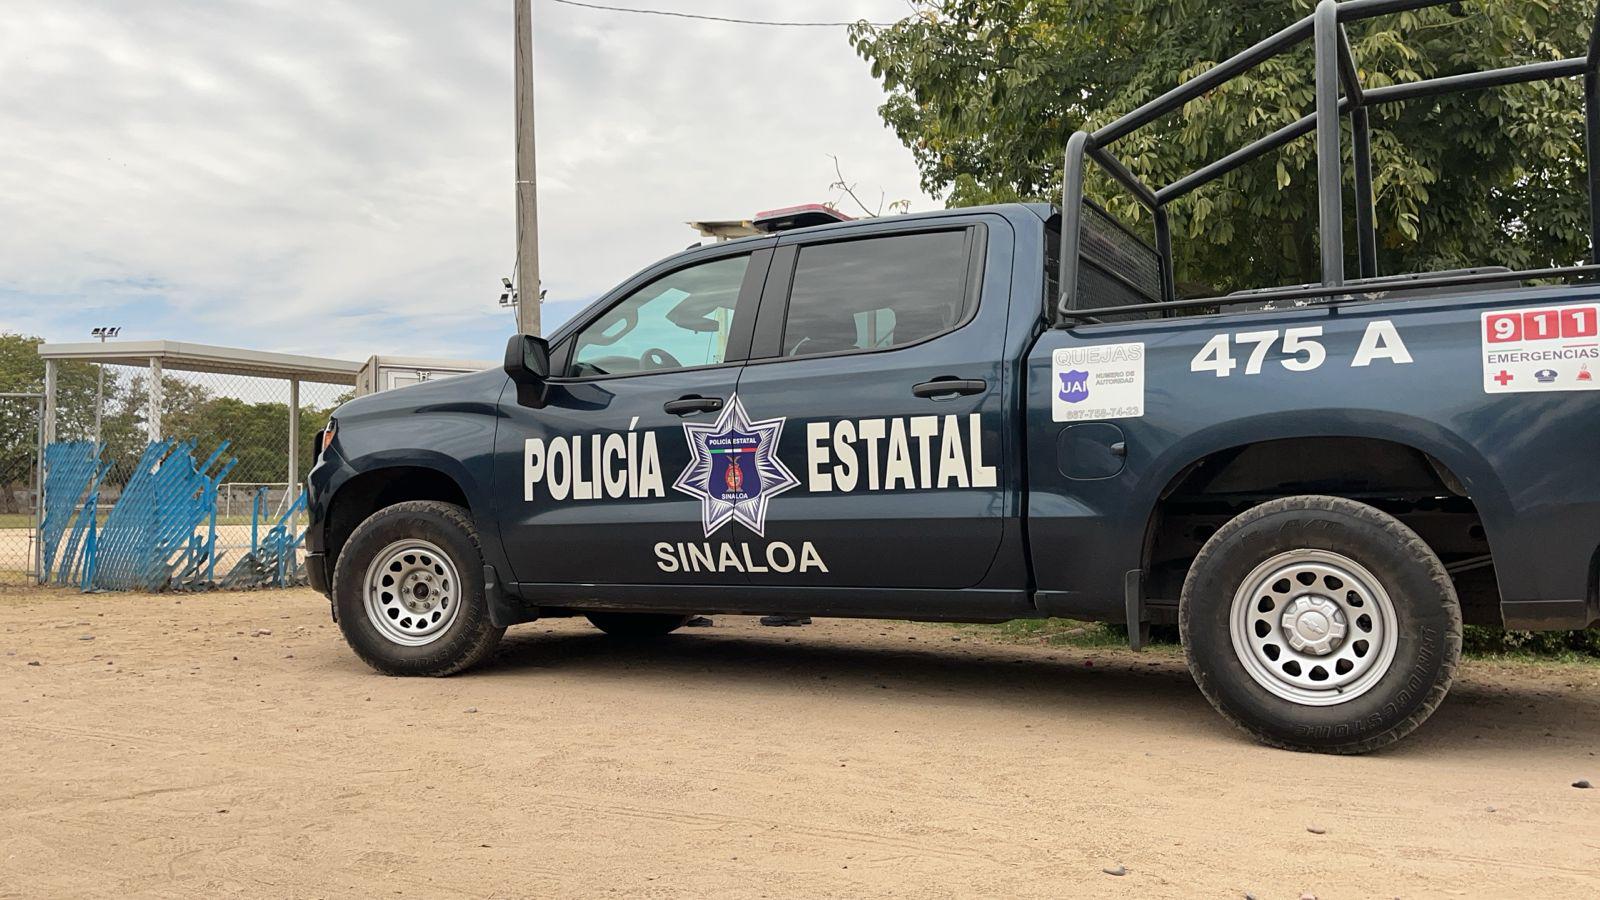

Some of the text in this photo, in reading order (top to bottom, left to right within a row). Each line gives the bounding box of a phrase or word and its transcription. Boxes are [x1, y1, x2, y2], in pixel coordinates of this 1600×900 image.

[1055, 345, 1142, 366] QUEJAS
[1190, 320, 1413, 378] 475 A
[1487, 348, 1599, 364] EMERGENCIAS
[1061, 381, 1086, 394] UAI
[709, 437, 756, 446] POLICÍA ESTATAL
[524, 413, 997, 502] POLICÍA ESTATAL
[655, 541, 829, 573] SINALOA
